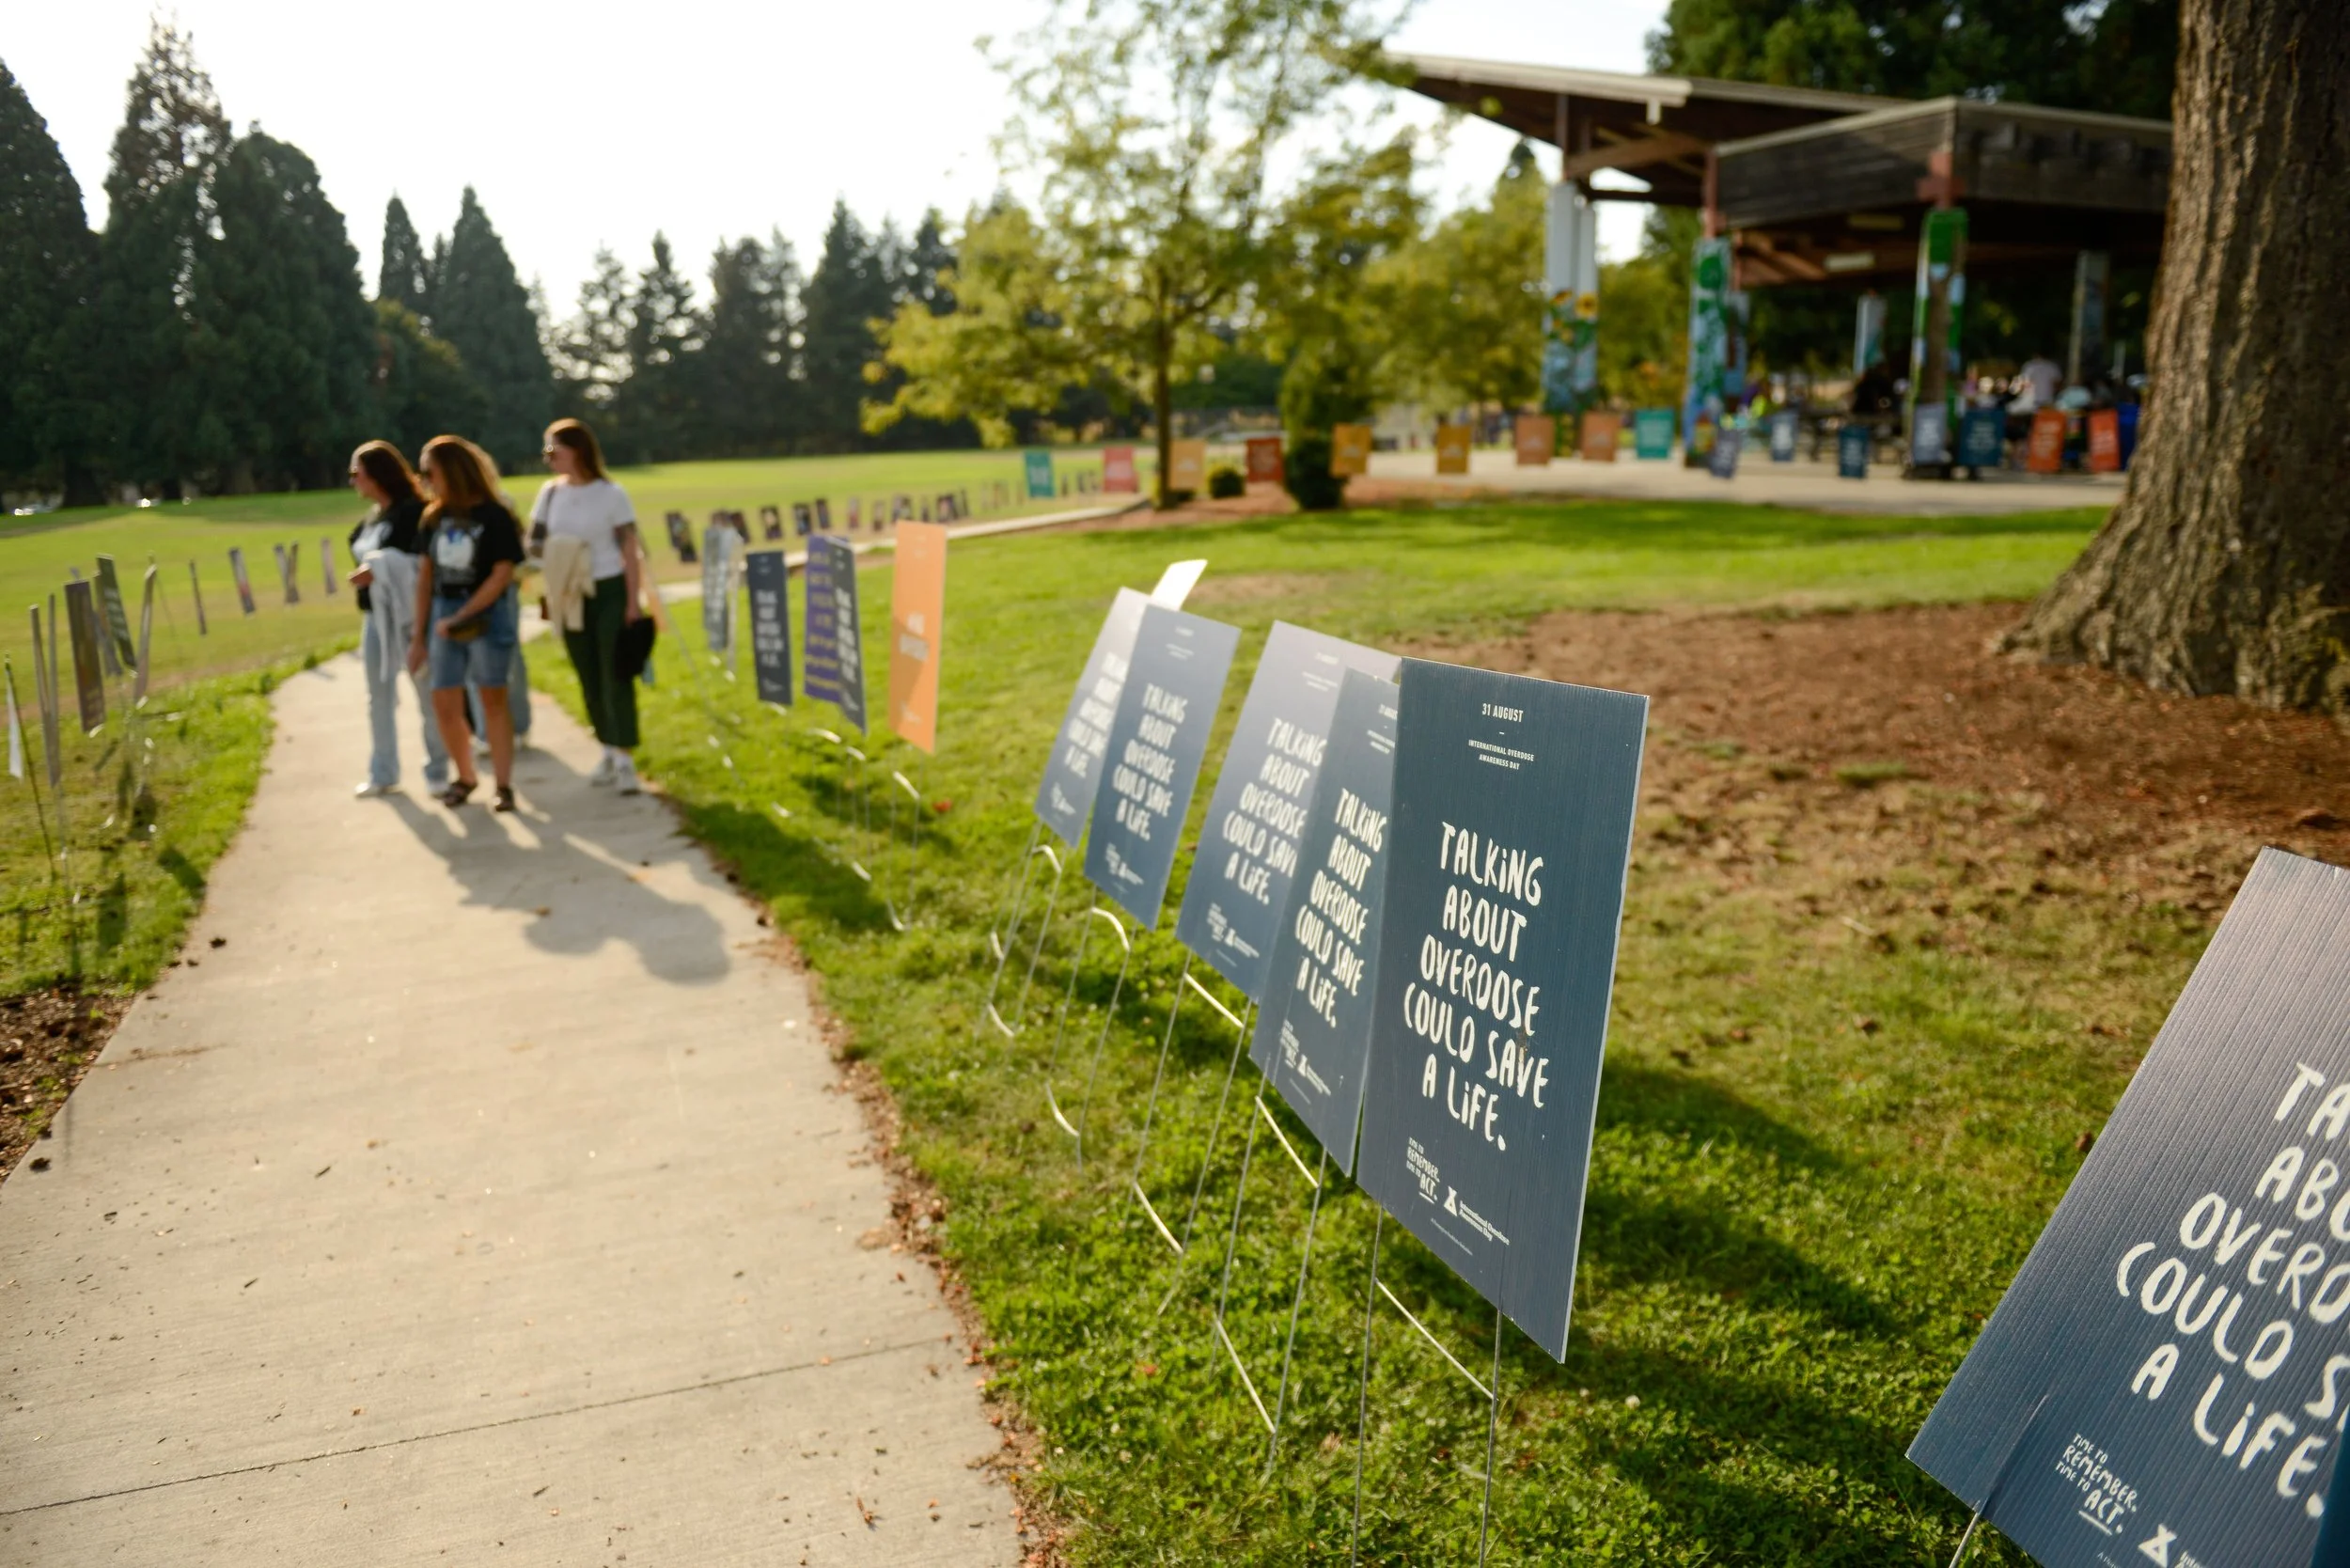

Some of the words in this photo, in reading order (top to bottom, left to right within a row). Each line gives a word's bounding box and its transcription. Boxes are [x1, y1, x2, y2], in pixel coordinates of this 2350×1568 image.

[1482, 703, 1491, 716] 31
[1493, 705, 1524, 722] AUGUST
[1468, 739, 1506, 755] INTERNATIONAL
[1508, 748, 1534, 761] OVERDOSE
[1479, 754, 1509, 767] AWARENESS
[1510, 761, 1520, 770] DAY
[1260, 753, 1310, 797] ABOUT
[1223, 810, 1266, 857] COULD
[1239, 782, 1308, 839] OVERDOSE
[1224, 852, 1240, 880] A
[1327, 834, 1371, 892] ABOUT
[1310, 870, 1369, 945] OVERDOSE
[1442, 885, 1528, 962] ABOUT
[1295, 904, 1333, 965] COULD
[1331, 940, 1364, 996] SAVE
[1296, 957, 1309, 991] A
[1420, 934, 1541, 1037] OVERDOSE
[1403, 982, 1475, 1064] COULD
[1485, 1030, 1549, 1108] SAVE
[1422, 1054, 1436, 1098] A
[2117, 1242, 2294, 1380] COULD
[2131, 1343, 2179, 1401] A
[2073, 1433, 2094, 1453] TIME
[2095, 1449, 2108, 1464] TO
[2055, 1461, 2076, 1482] TIME
[2077, 1477, 2091, 1492] TO
[2062, 1444, 2138, 1513] REMEMBER.
[2084, 1489, 2123, 1534] ACT.
